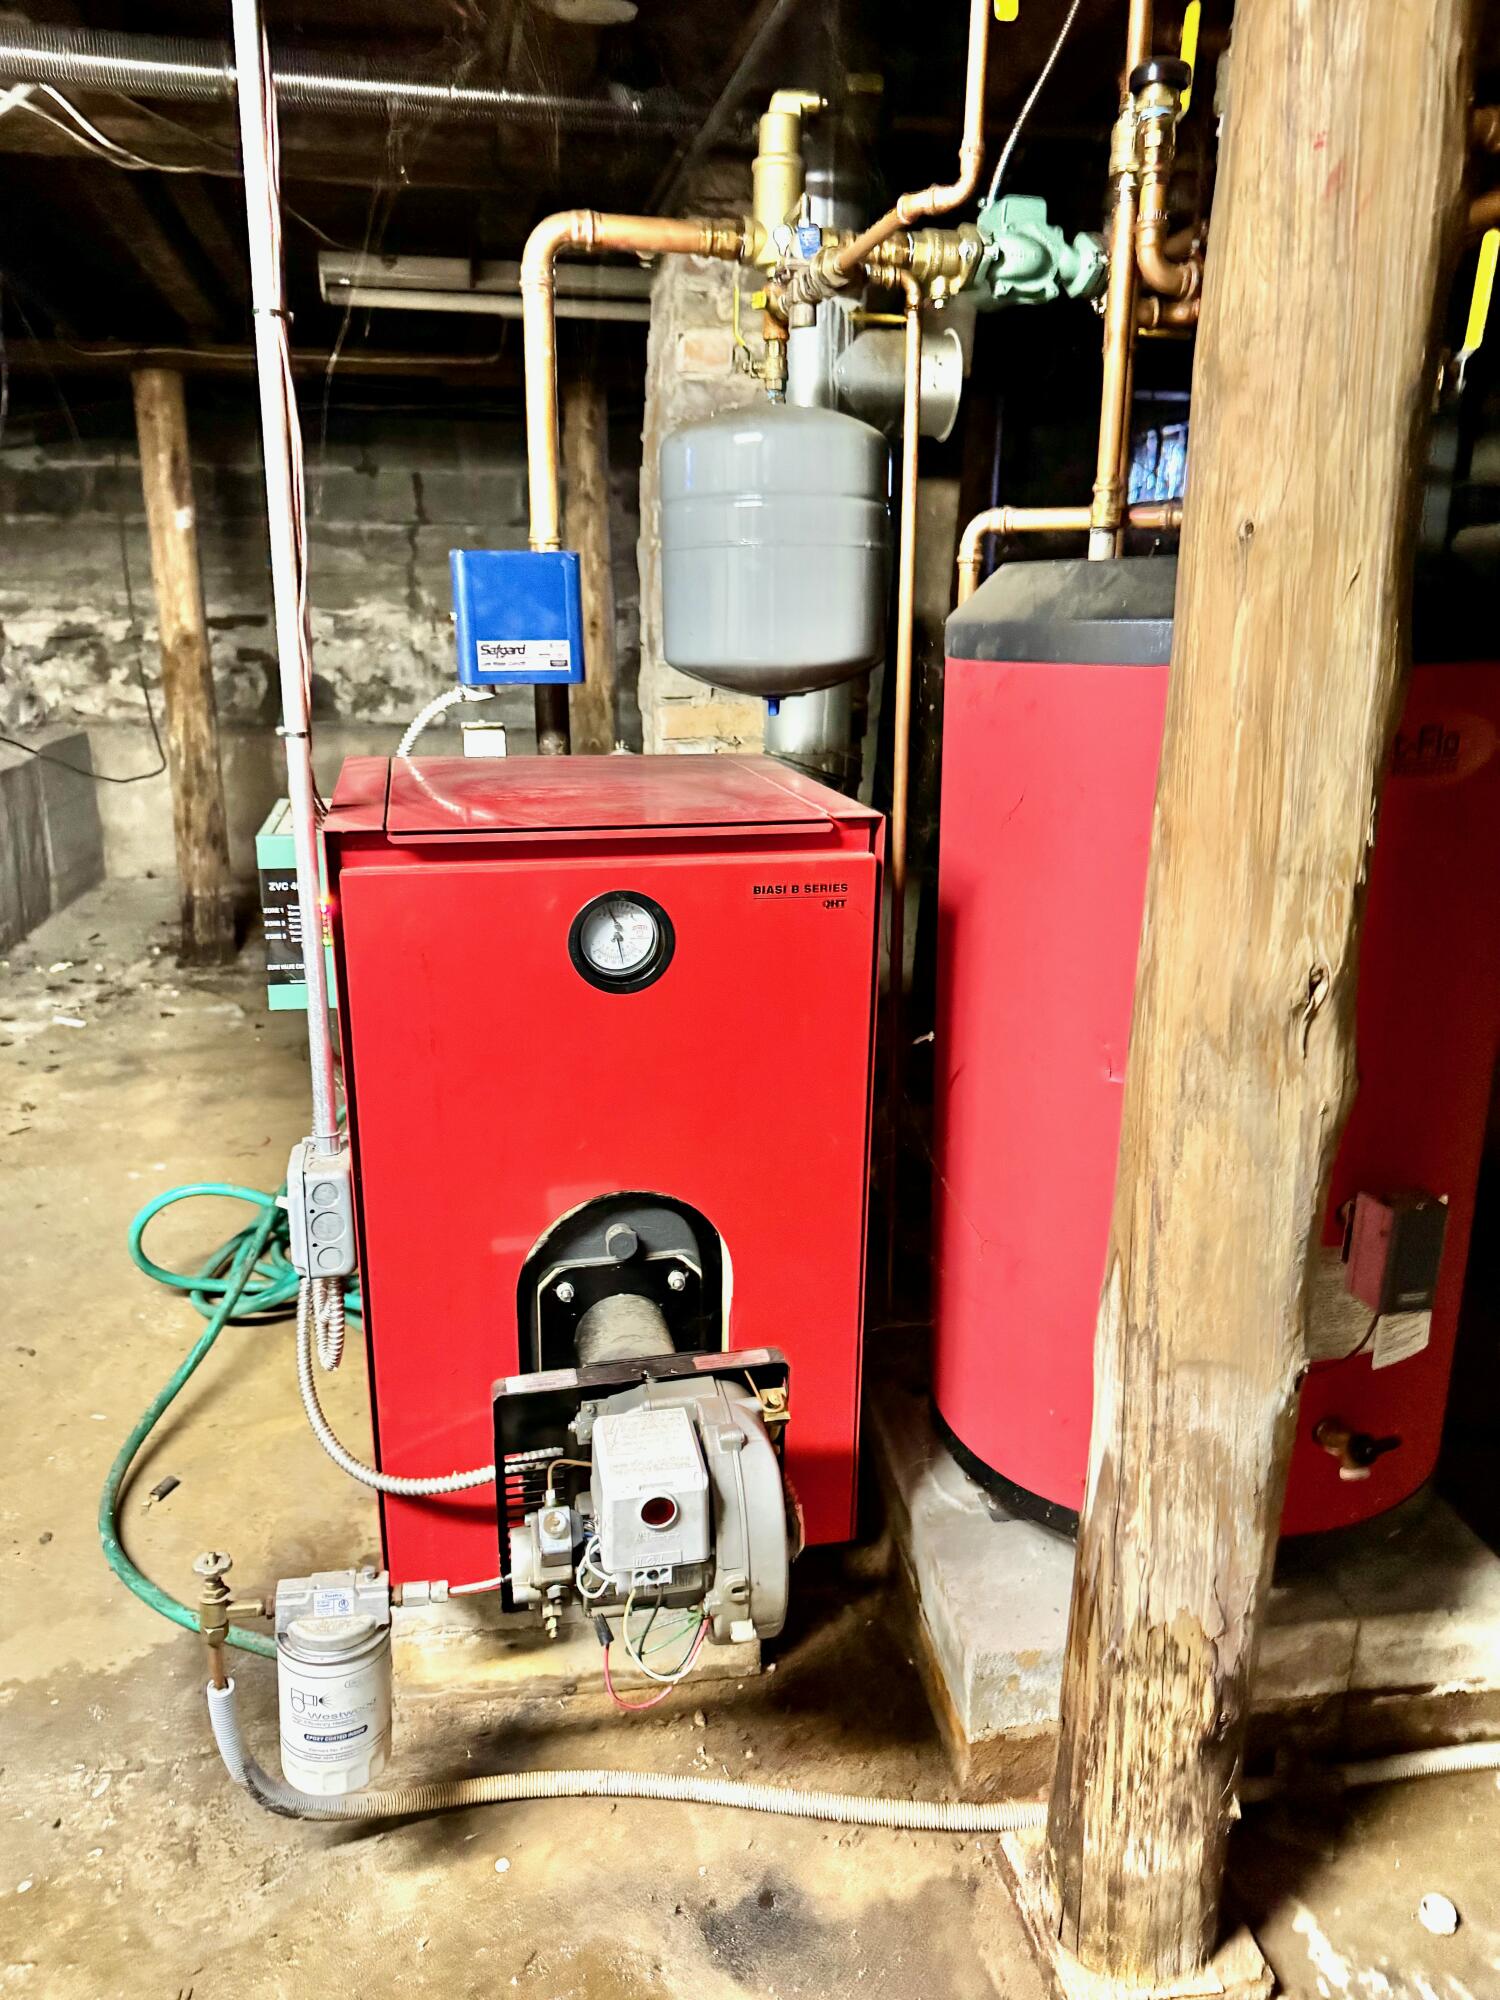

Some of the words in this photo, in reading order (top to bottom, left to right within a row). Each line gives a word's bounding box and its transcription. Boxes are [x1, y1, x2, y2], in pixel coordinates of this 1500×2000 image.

[480, 644, 526, 658] Safgard
[268, 882, 289, 891] ZVC
[753, 885, 787, 895] BIASI
[791, 885, 800, 894] B
[804, 883, 848, 893] SERIES
[822, 899, 847, 910] QHT
[306, 1734, 324, 1742] EPOXY
